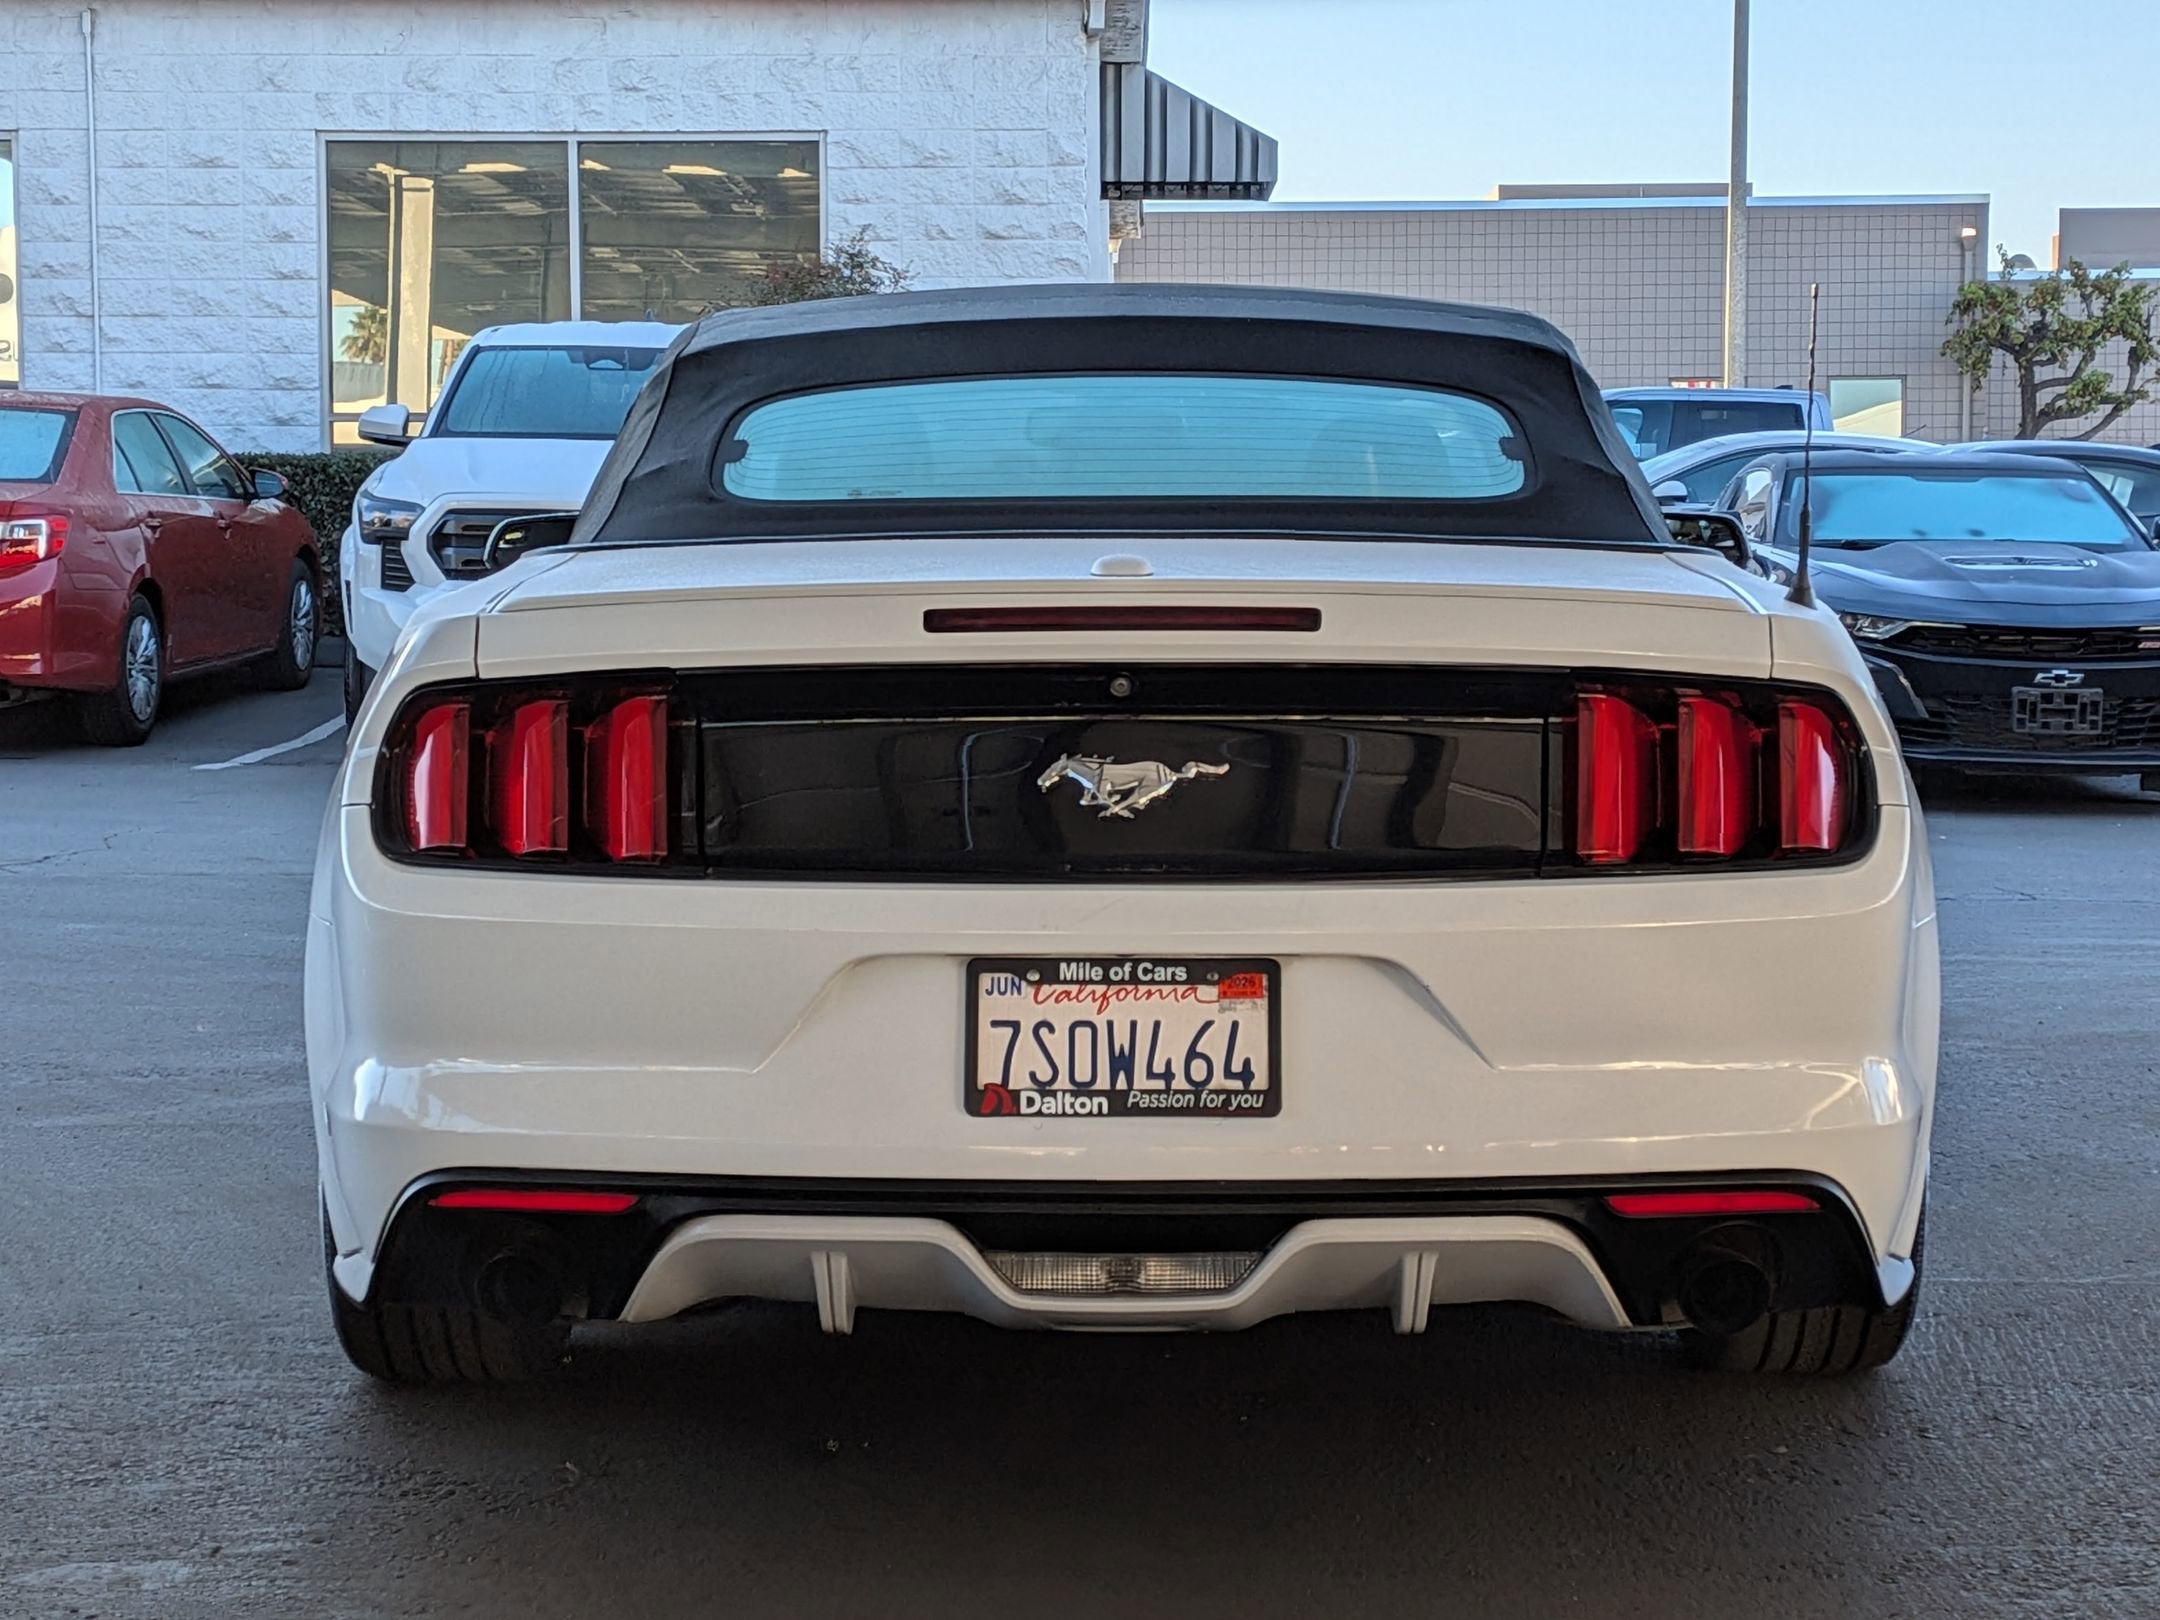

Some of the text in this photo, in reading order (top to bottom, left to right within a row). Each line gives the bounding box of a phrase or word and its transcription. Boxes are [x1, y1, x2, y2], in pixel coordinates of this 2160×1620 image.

[1060, 962, 1187, 981] Mile of Cars
[985, 976, 1023, 996] JUN
[1033, 984, 1219, 1015] California
[1020, 1090, 1108, 1114] Dalton
[1127, 1090, 1264, 1110] Passion for you
